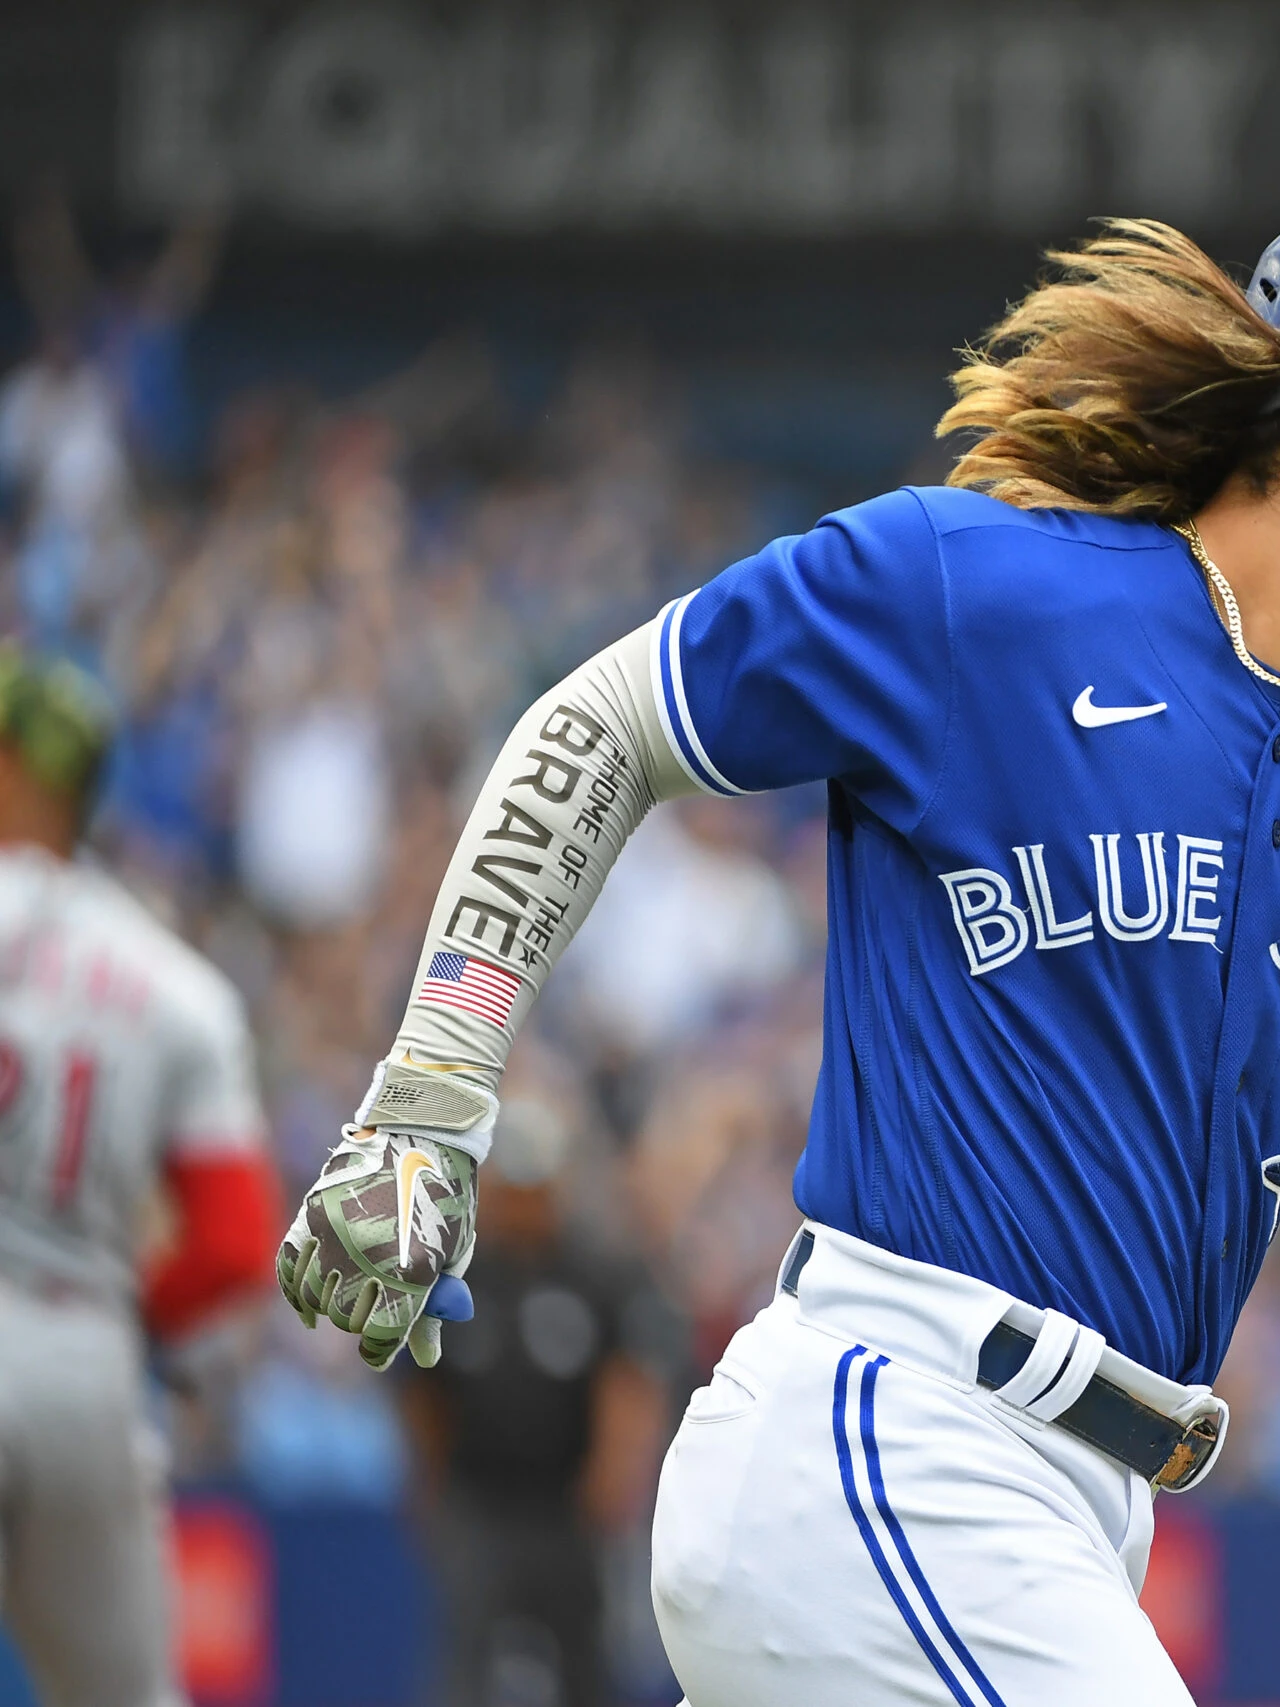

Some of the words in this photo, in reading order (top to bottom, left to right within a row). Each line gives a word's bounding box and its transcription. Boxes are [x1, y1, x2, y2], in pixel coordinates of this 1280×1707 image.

[444, 704, 606, 959] BRAVE
[573, 761, 621, 845] HOME
[558, 845, 588, 890] OF
[938, 832, 1224, 976] BLUE
[524, 896, 570, 953] THE
